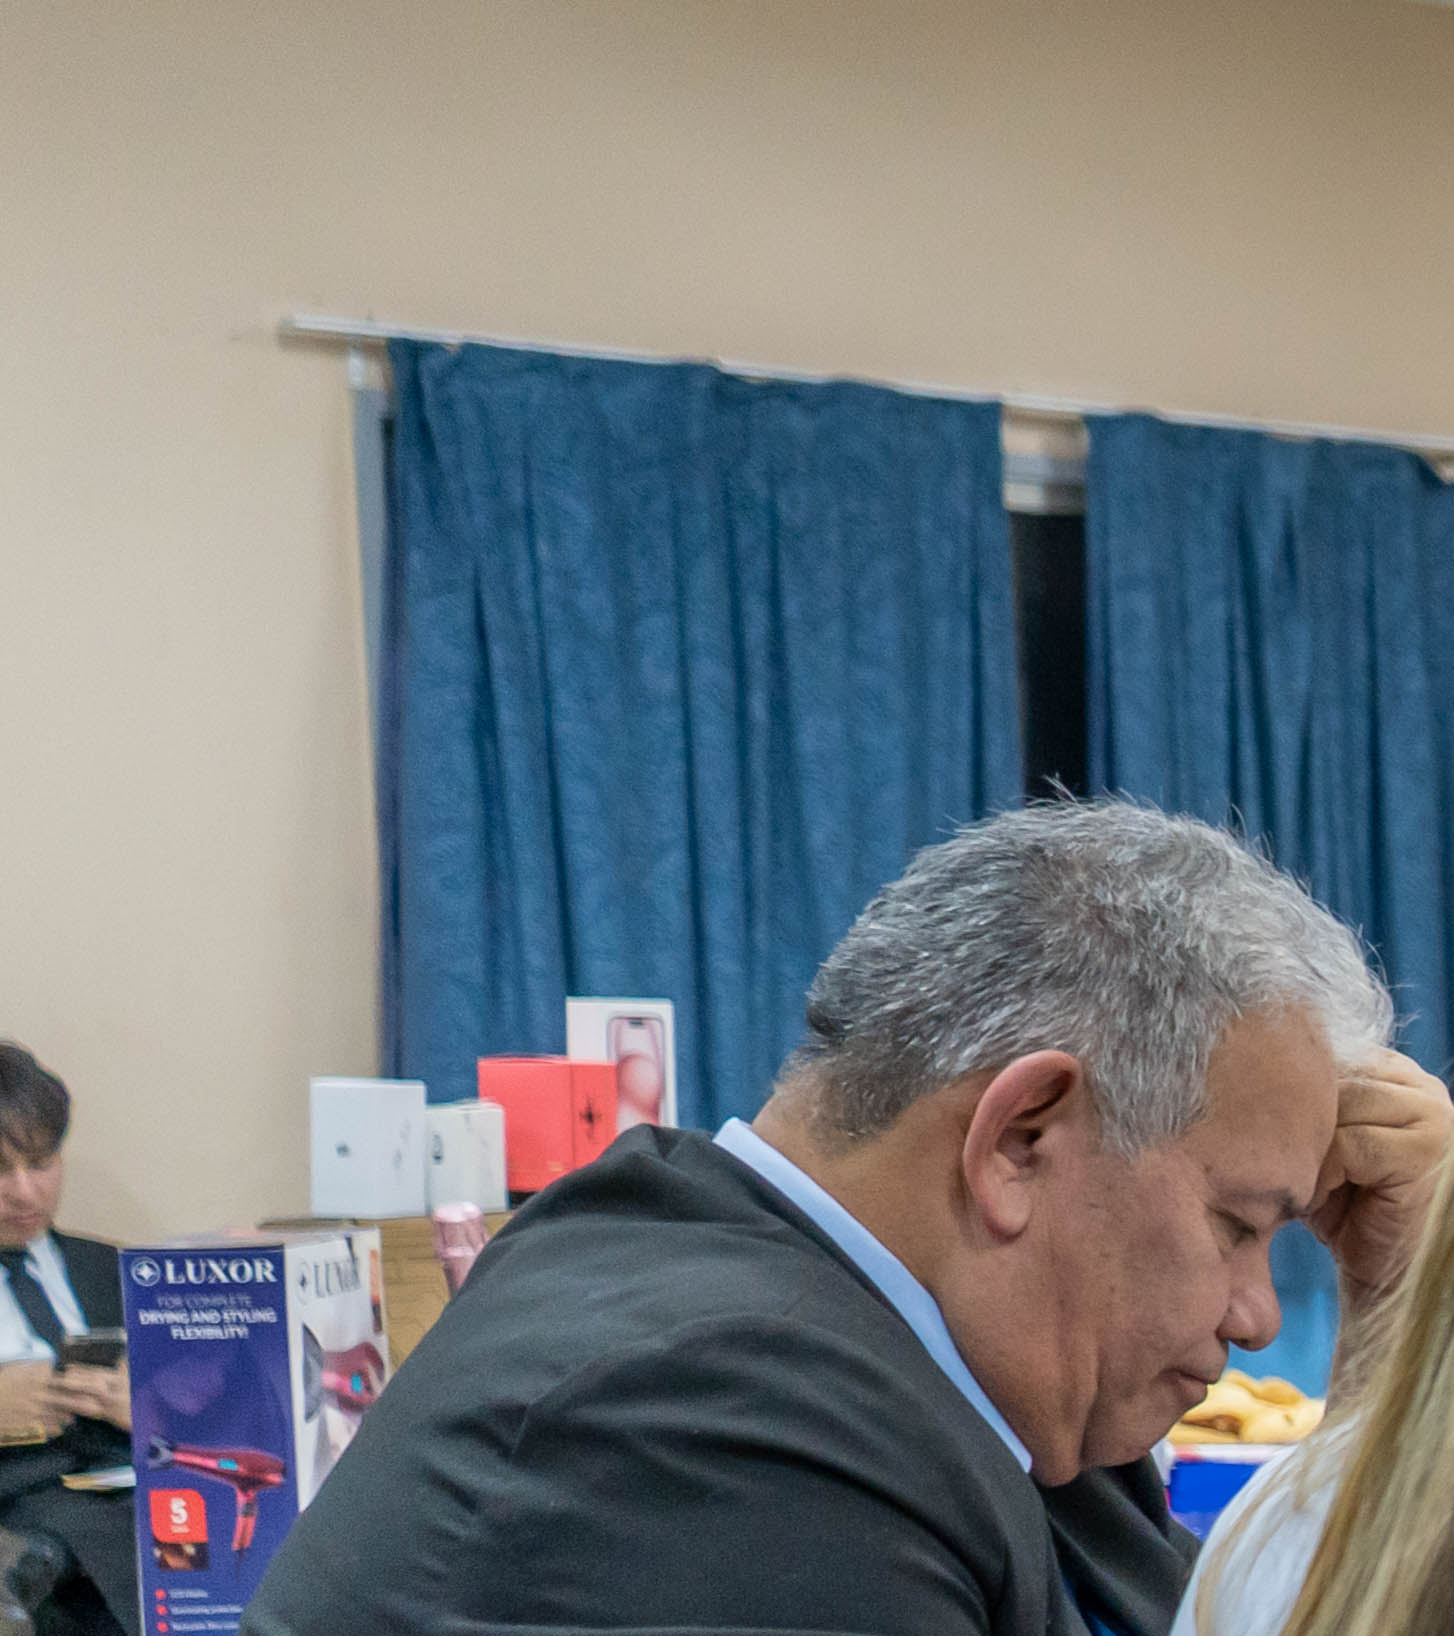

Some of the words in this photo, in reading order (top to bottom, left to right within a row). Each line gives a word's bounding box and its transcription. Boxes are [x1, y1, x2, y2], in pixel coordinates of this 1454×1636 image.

[165, 1257, 278, 1285] LUXOR
[139, 1309, 190, 1325] DRYING
[191, 1309, 221, 1324] AND
[222, 1308, 278, 1323] STYLING
[169, 1497, 188, 1524] 5
